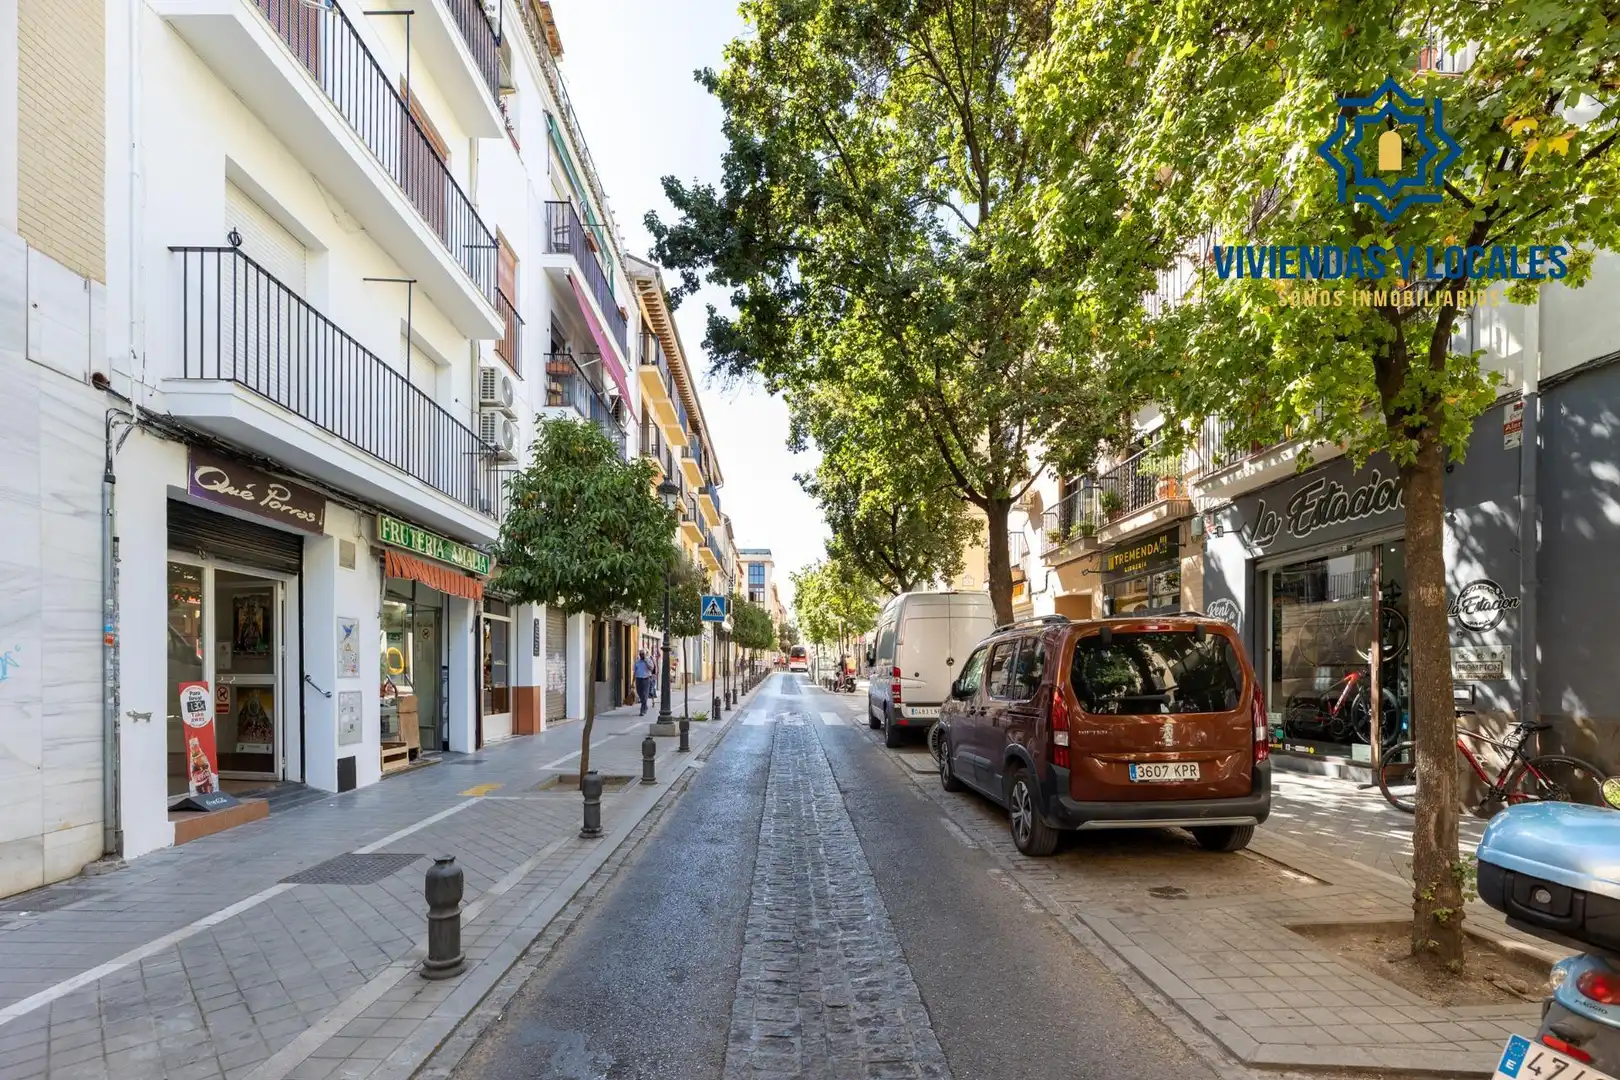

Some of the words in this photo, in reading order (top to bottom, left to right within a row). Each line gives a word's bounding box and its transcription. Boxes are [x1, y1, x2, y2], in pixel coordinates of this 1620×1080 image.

[194, 465, 255, 501] Qué
[1248, 499, 1282, 549] La
[451, 546, 487, 573] AMALIA
[1206, 601, 1230, 618] Rent
[1447, 600, 1462, 618] La
[1138, 765, 1169, 777] 3607
[1174, 765, 1197, 776] KPR
